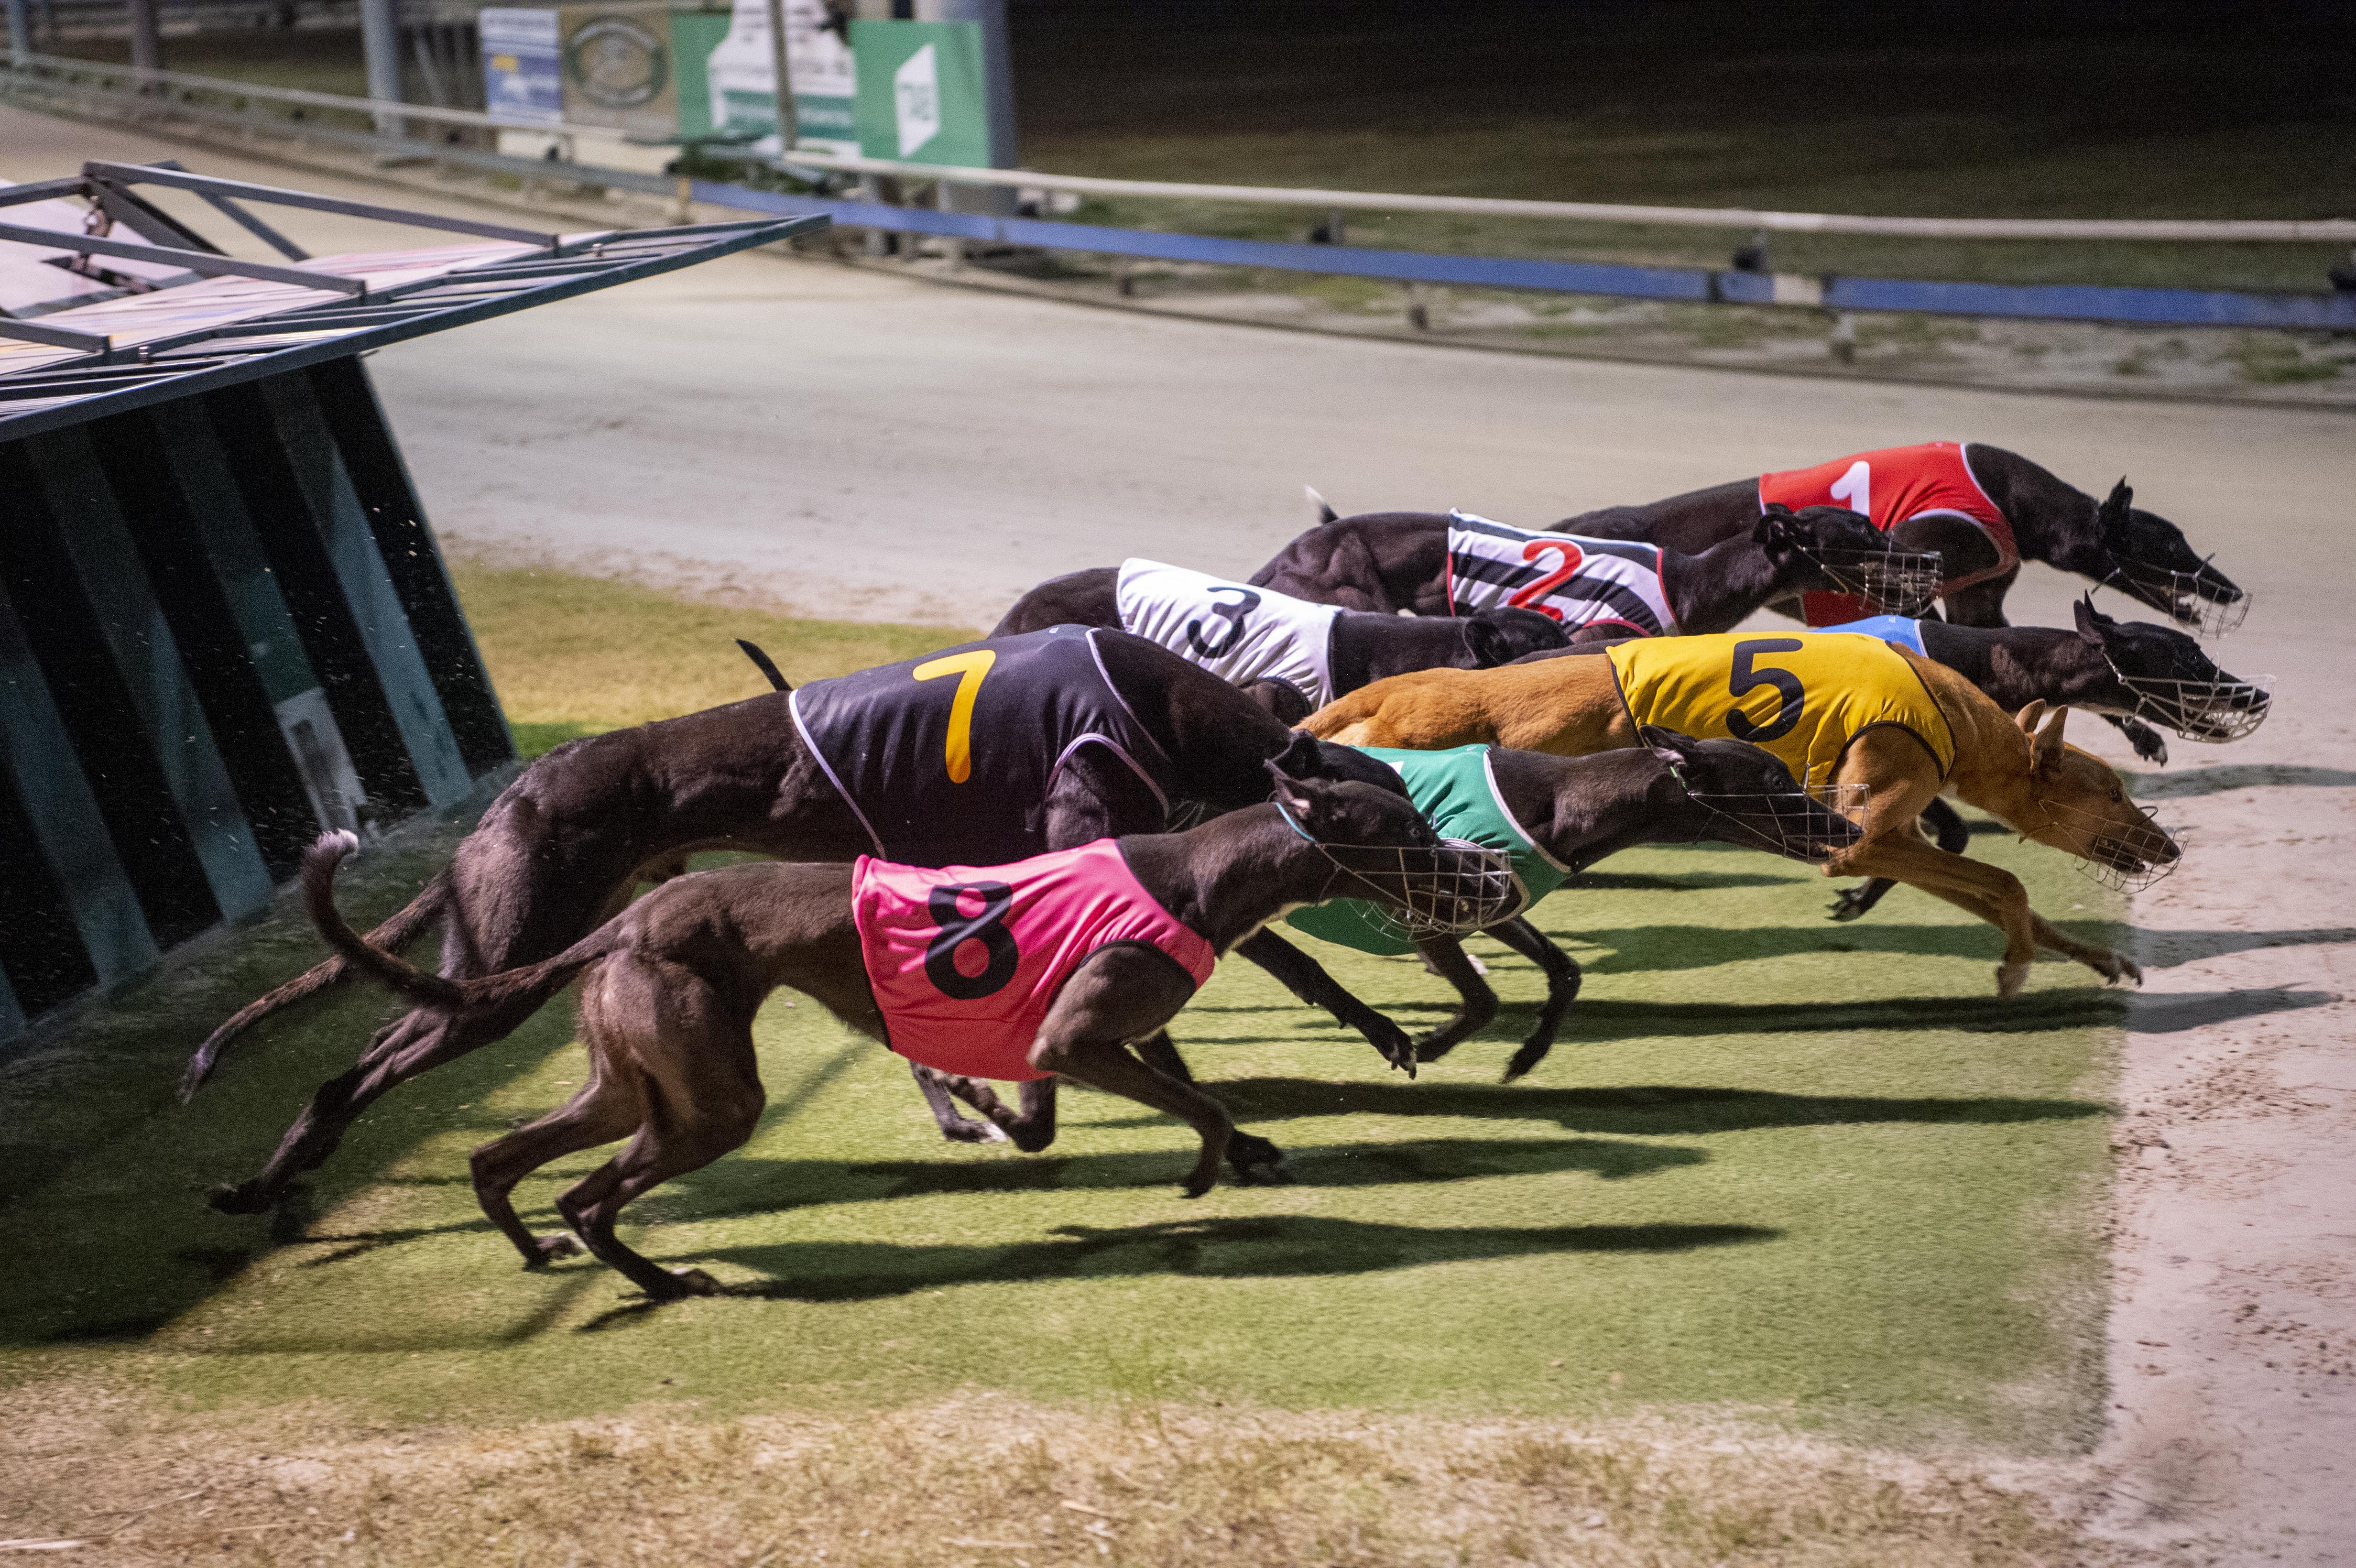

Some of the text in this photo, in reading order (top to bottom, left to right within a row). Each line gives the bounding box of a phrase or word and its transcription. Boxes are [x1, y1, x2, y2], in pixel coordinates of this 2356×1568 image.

[1830, 461, 1870, 517] 1
[1187, 587, 1261, 658] 3
[1507, 539, 1582, 621] 2
[913, 649, 996, 783] 7
[1724, 638, 1805, 742] 5
[925, 881, 1018, 999] 8
